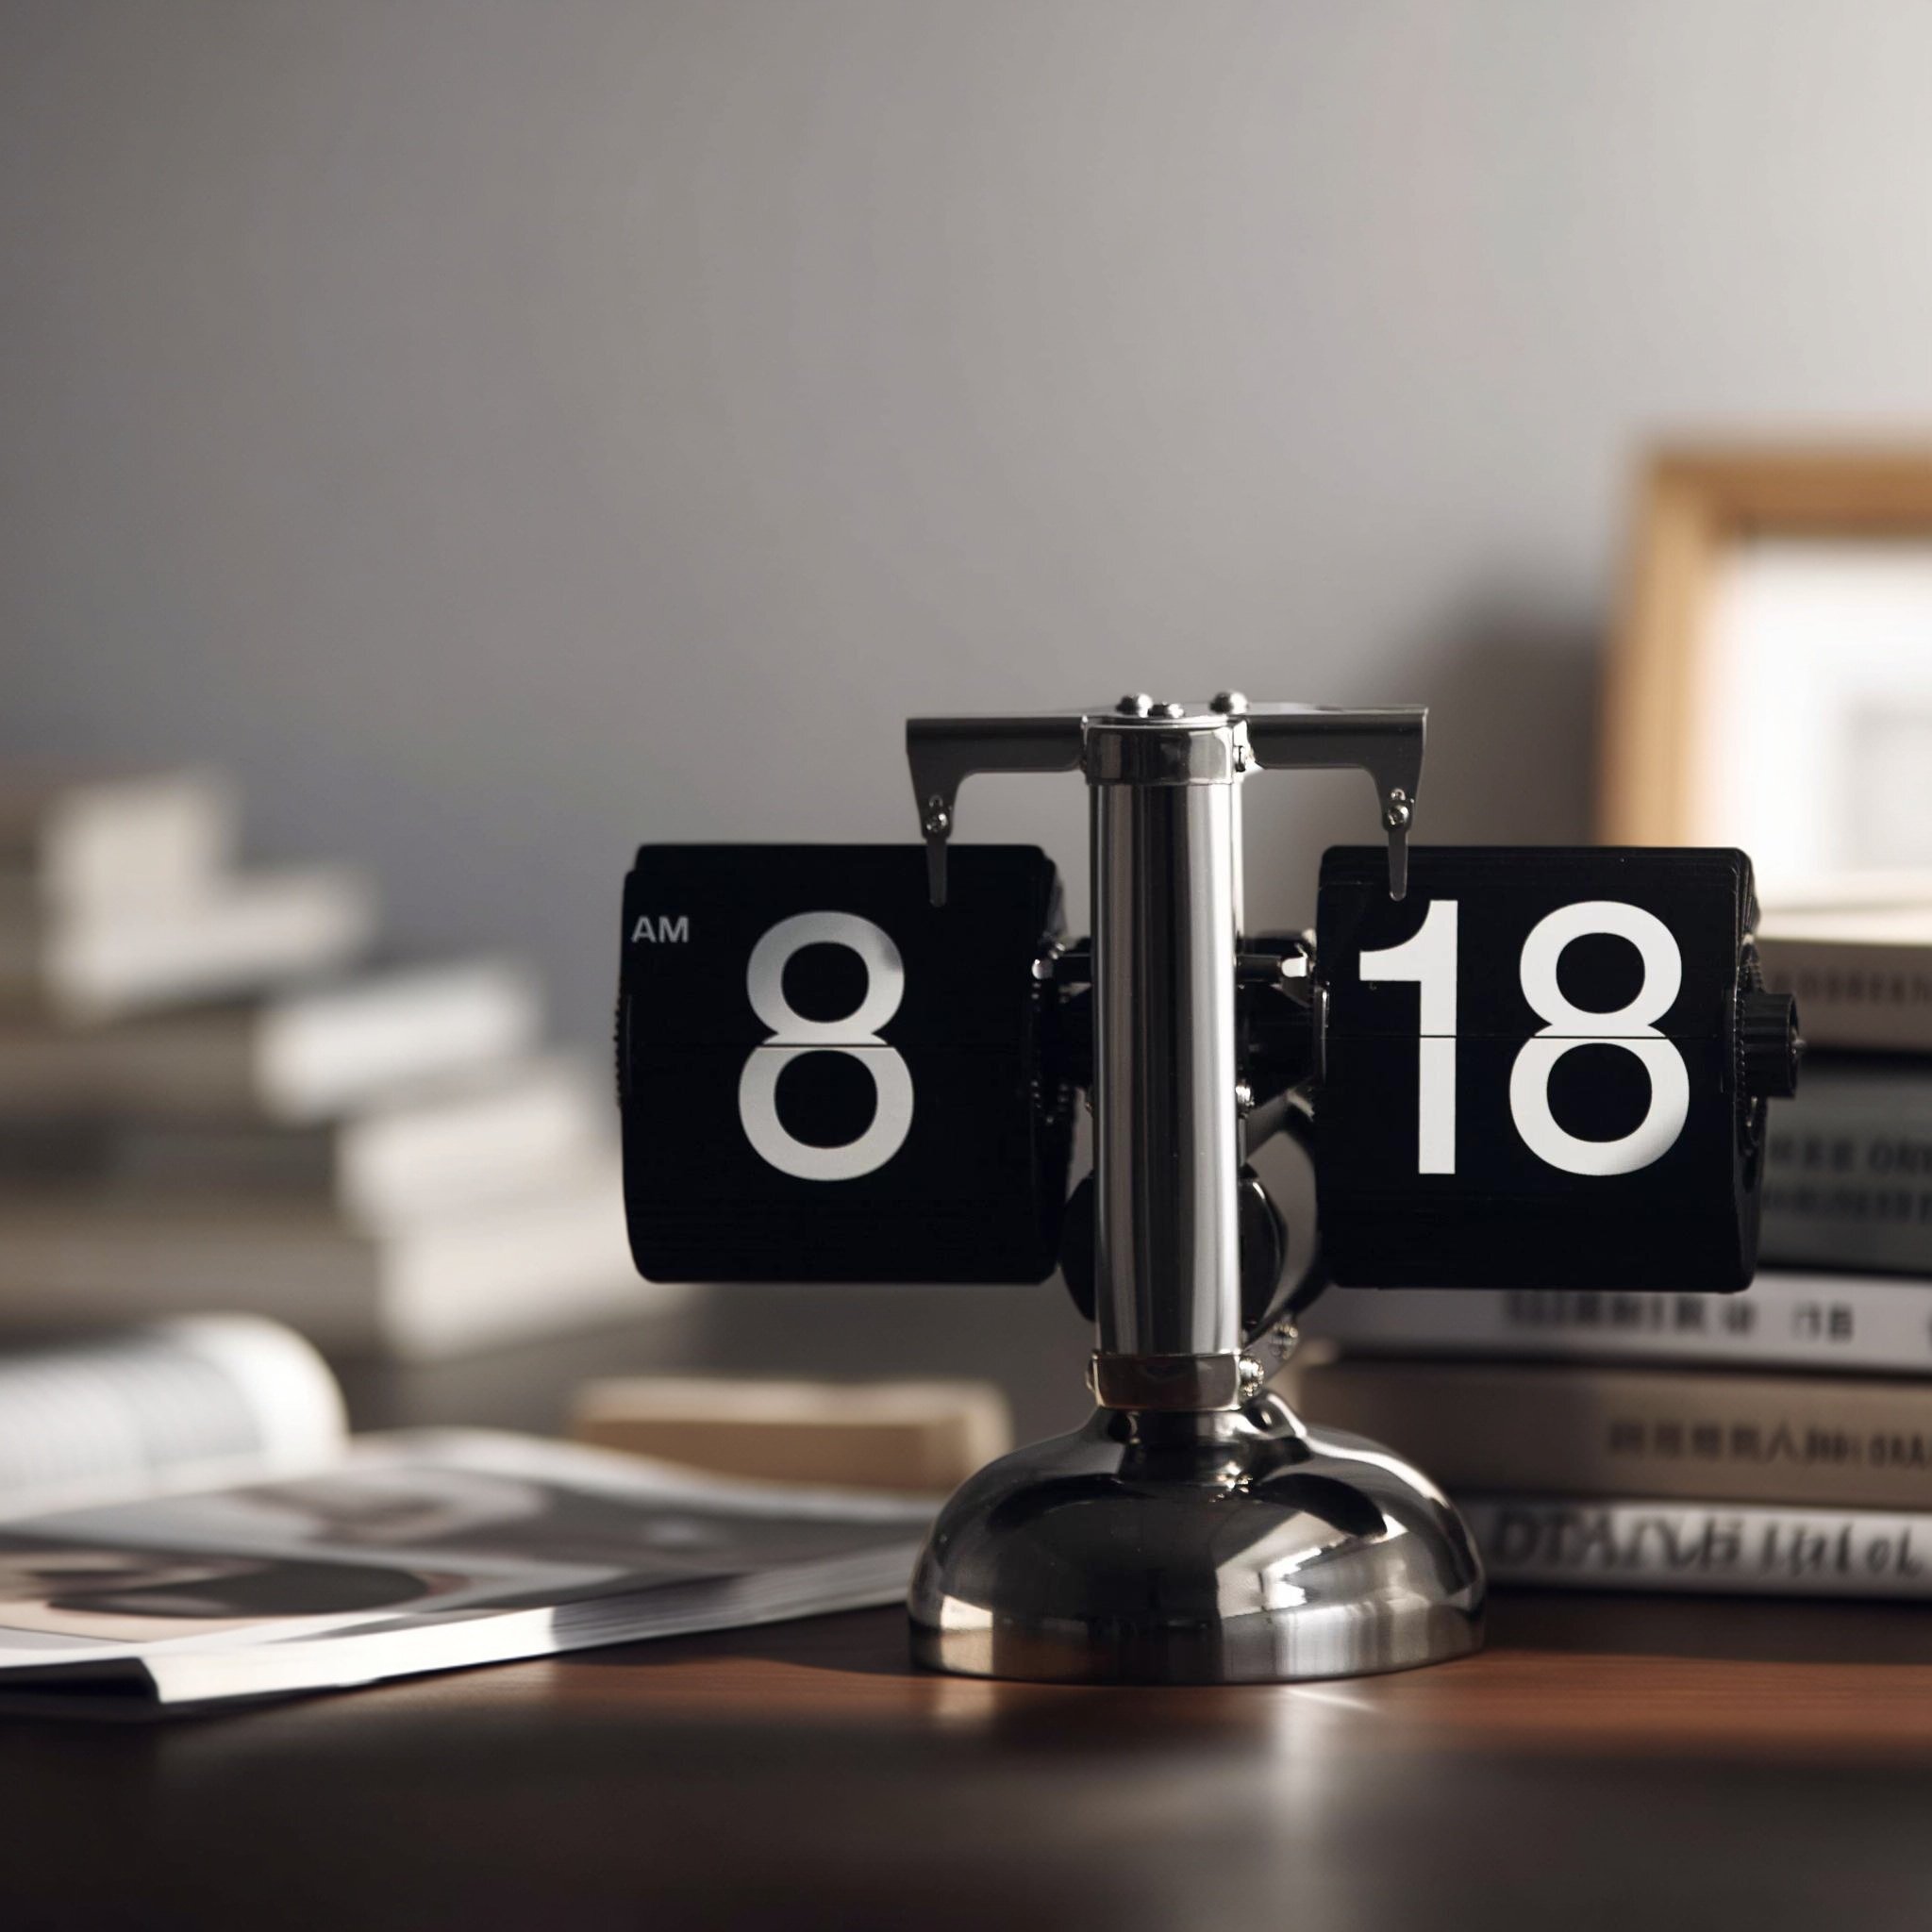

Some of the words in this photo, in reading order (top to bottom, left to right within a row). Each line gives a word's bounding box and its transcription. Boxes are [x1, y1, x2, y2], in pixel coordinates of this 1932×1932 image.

[630, 916, 689, 942] AM
[739, 911, 914, 1181] 8
[1358, 899, 1690, 1176] 18
